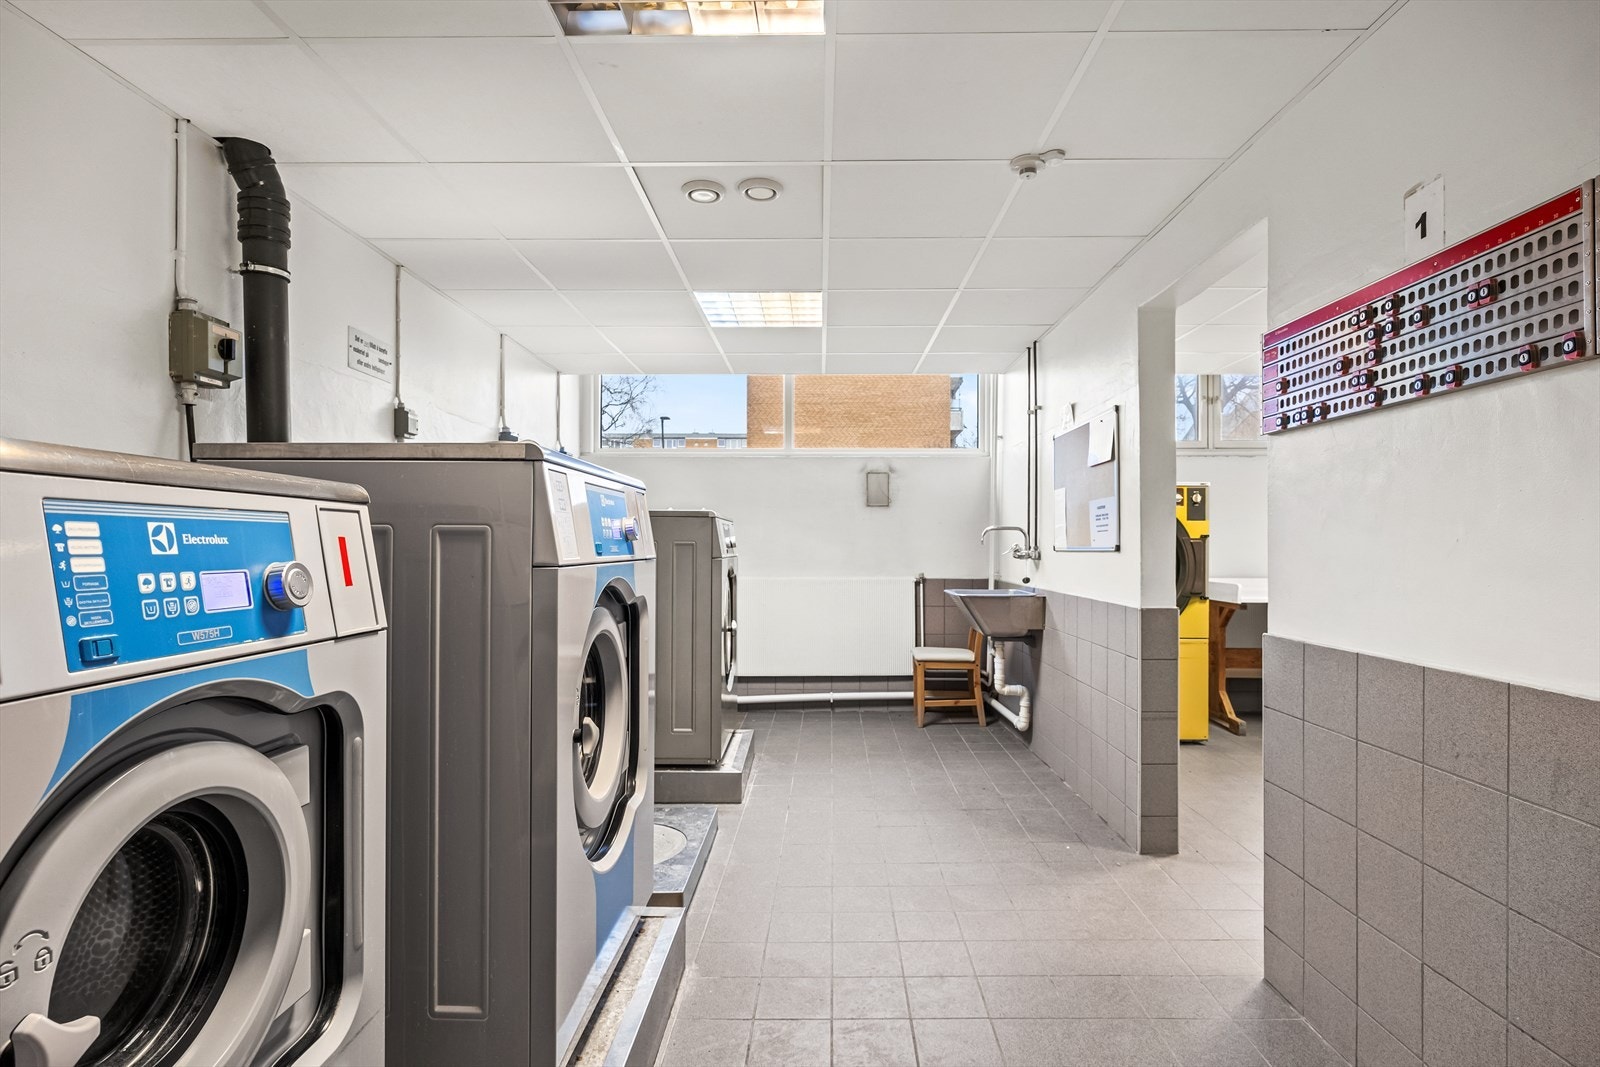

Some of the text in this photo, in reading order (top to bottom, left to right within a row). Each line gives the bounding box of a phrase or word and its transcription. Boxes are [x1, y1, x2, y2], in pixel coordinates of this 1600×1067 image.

[1415, 211, 1427, 239] 1
[182, 533, 229, 544] Electrolux
[191, 628, 220, 641] W575H
